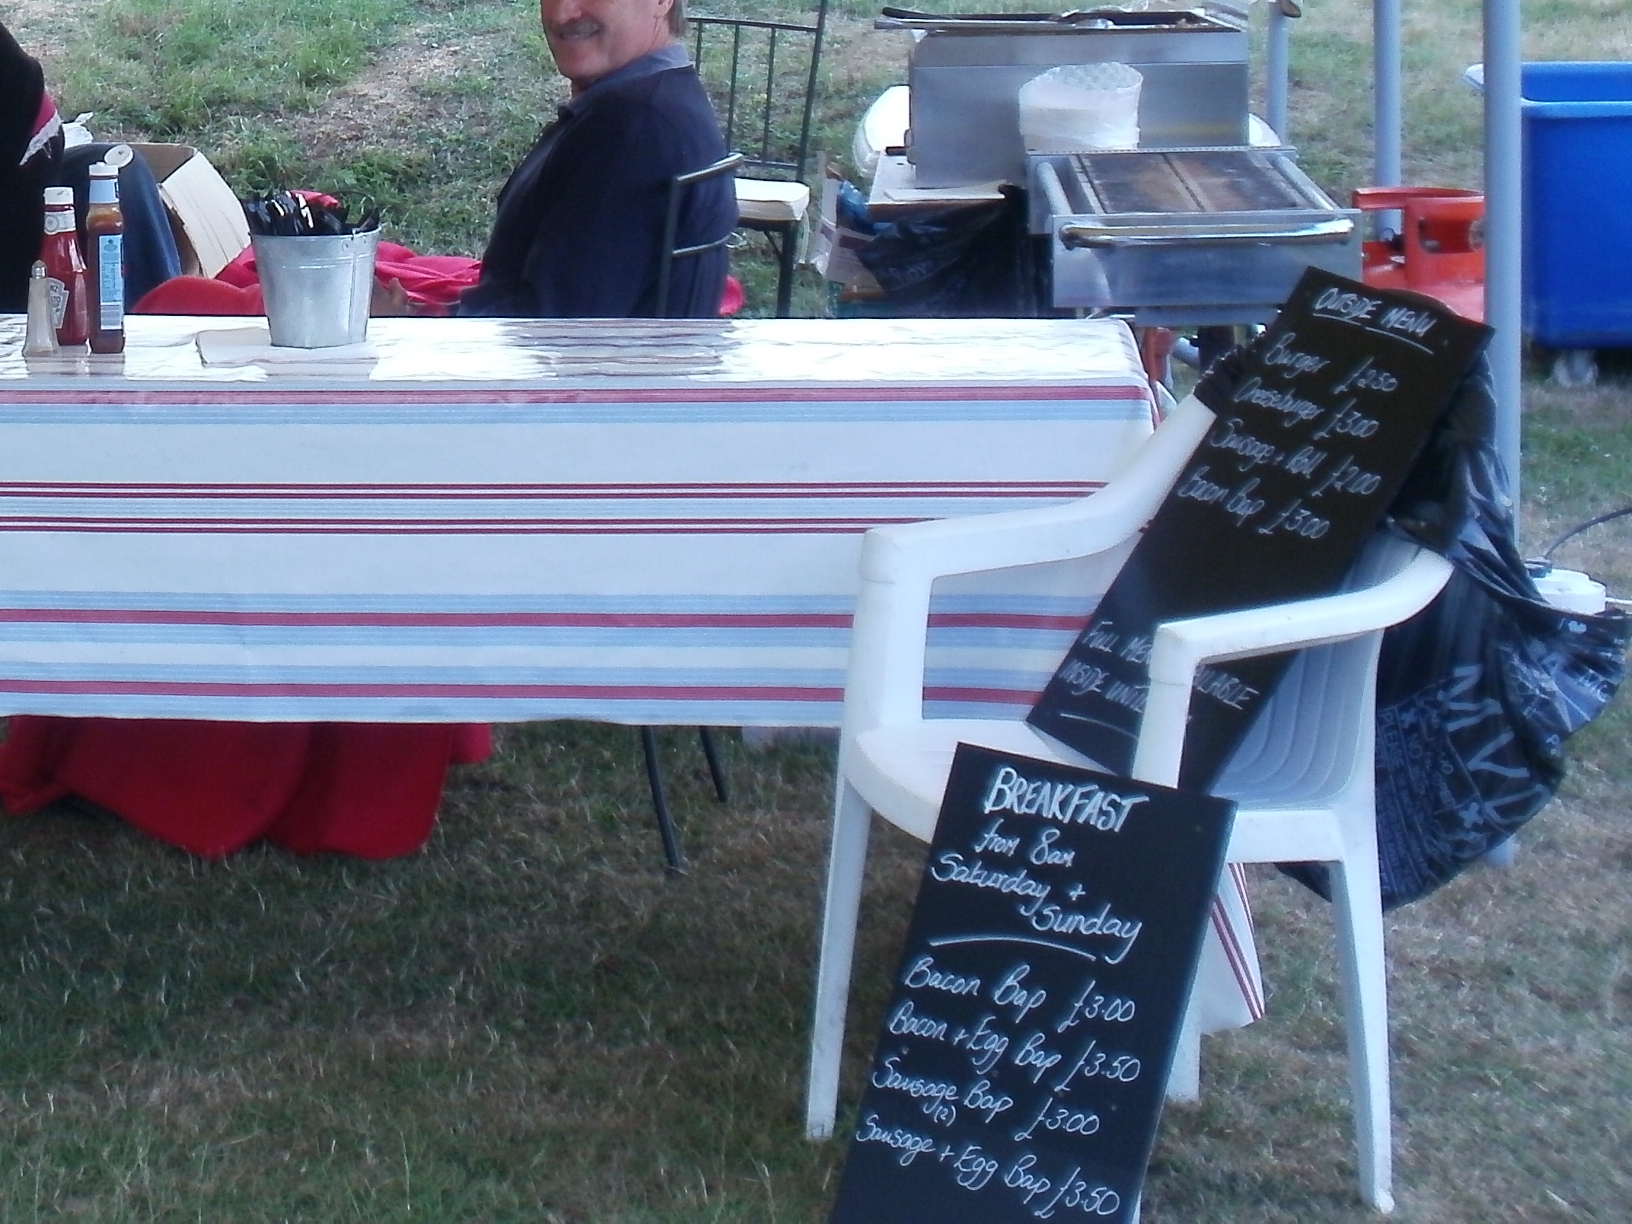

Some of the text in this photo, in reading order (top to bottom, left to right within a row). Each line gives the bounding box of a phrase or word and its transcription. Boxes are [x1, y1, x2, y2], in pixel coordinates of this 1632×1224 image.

[1380, 307, 1437, 338] MENU
[1265, 332, 1331, 379] Burger
[1210, 417, 1275, 472] Sausage
[984, 766, 1150, 833] BREAKFAST
[1030, 828, 1076, 868] 8am
[931, 853, 1050, 916] Saturday
[1032, 903, 1143, 965] Sunday
[905, 956, 980, 998] Bacon
[992, 964, 1047, 1022] Bap
[889, 1002, 947, 1043] Bacon
[965, 1016, 1011, 1074] Egg
[1014, 1033, 1062, 1084] Bap
[1054, 1040, 1141, 1093] £3.50
[872, 1056, 1100, 1142] Sausage Bap £3.00
[933, 1105, 957, 1127] (2)
[855, 1114, 936, 1167] Sausage
[953, 1144, 999, 1191] Egg
[1003, 1153, 1052, 1205] Bap
[1034, 1166, 1121, 1220] £3.50
